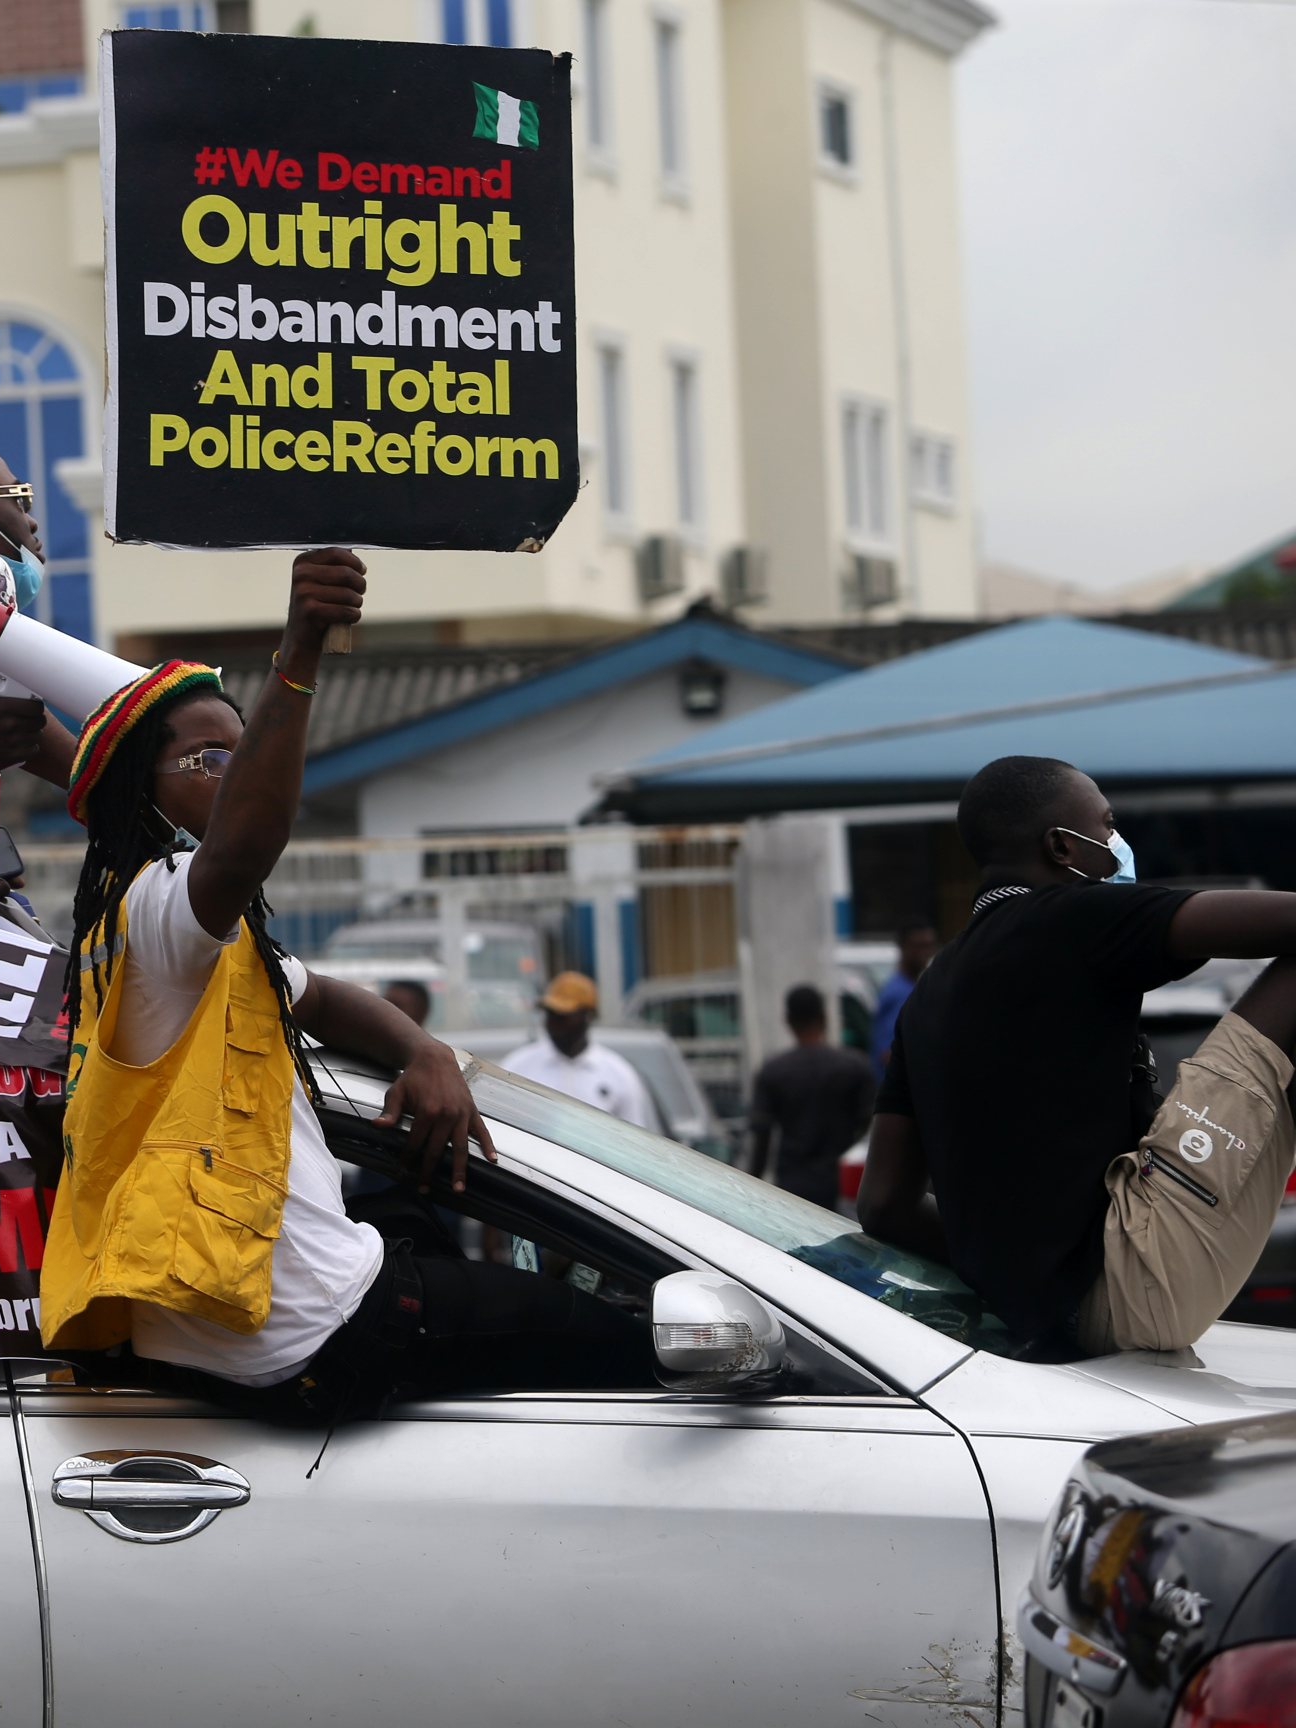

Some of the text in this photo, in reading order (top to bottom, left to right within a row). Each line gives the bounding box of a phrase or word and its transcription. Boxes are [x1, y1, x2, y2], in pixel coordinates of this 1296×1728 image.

[194, 146, 512, 199] #We Demand
[182, 194, 522, 287] Outright
[143, 281, 561, 353] Disbandment
[198, 350, 511, 416] And Total
[150, 413, 560, 480] PoliceReform
[65, 1460, 109, 1470] CAMRY
